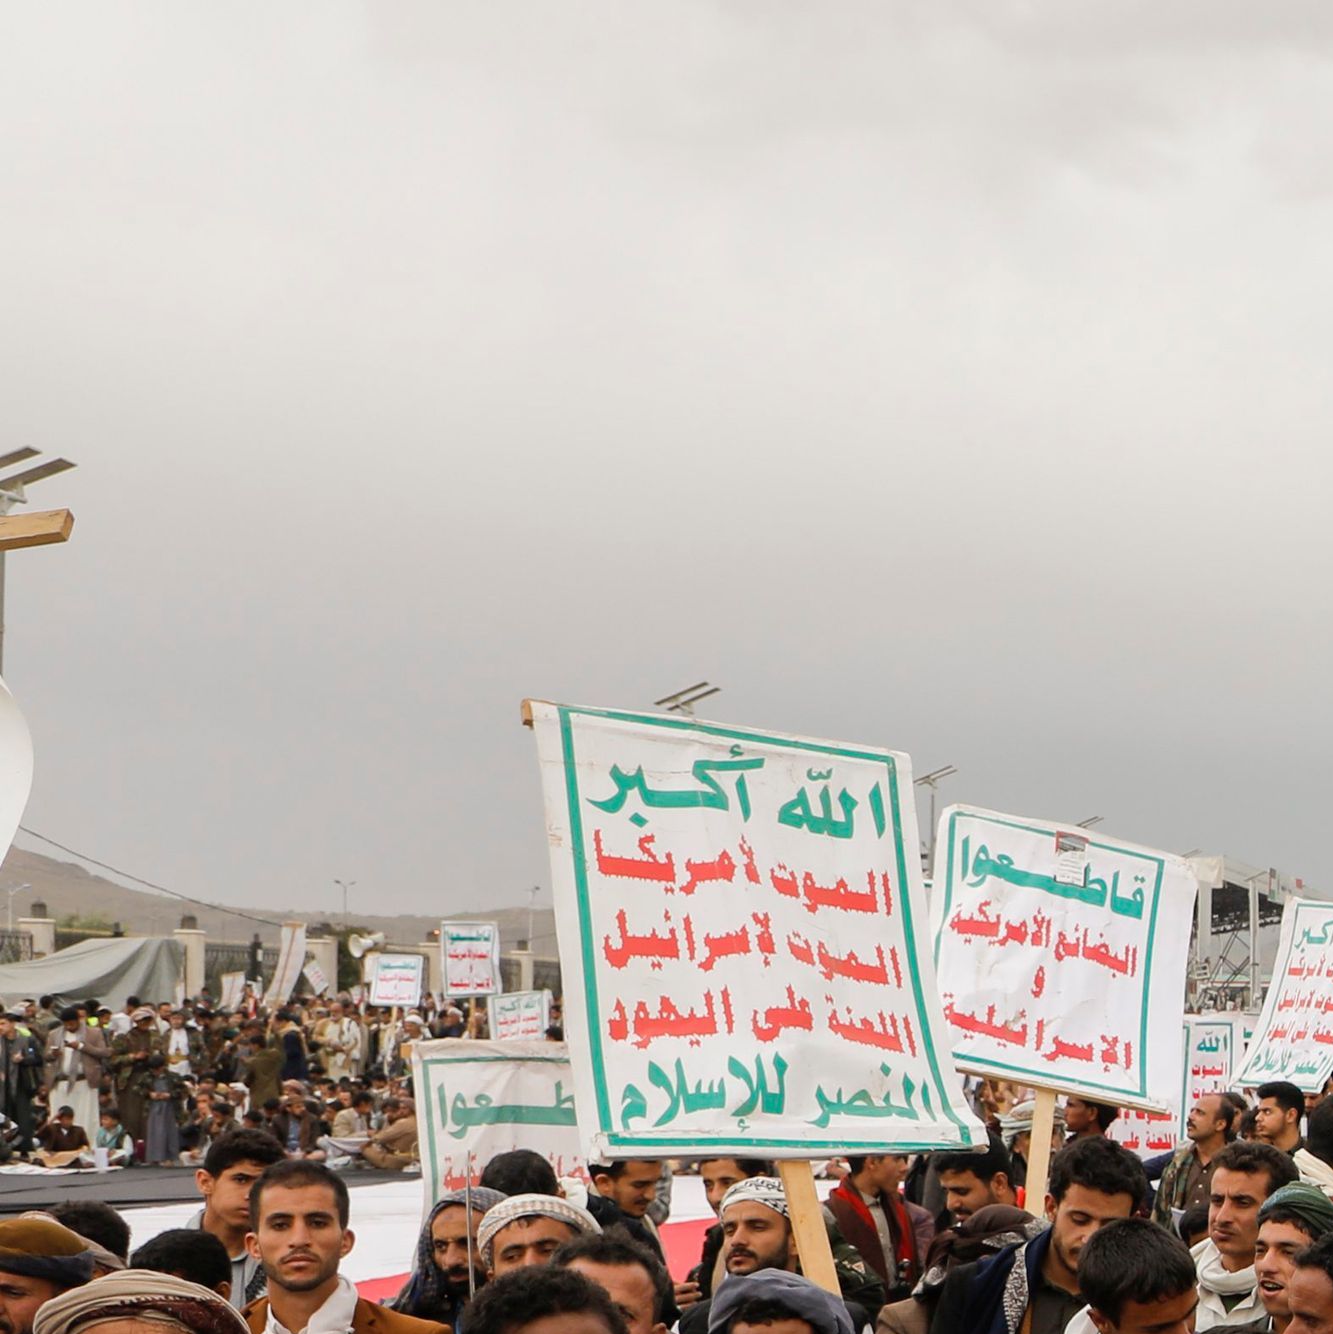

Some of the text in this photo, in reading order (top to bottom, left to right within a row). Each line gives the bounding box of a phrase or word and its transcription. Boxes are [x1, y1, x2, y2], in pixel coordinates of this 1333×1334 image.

[585, 744, 765, 828] أكبر
[593, 828, 892, 916] الموت لأمريكا
[962, 835, 1145, 920] قاطعوا
[603, 908, 903, 988] الموت لإسرائيل
[950, 900, 1138, 977] البضائع الأمريكية
[607, 984, 917, 1057] اللعنة على اليهود
[1031, 965, 1045, 998] و
[943, 993, 1131, 1073] الإسرائيلية
[437, 1080, 577, 1140] طعوا
[621, 1051, 936, 1133] النصر للإسلام
